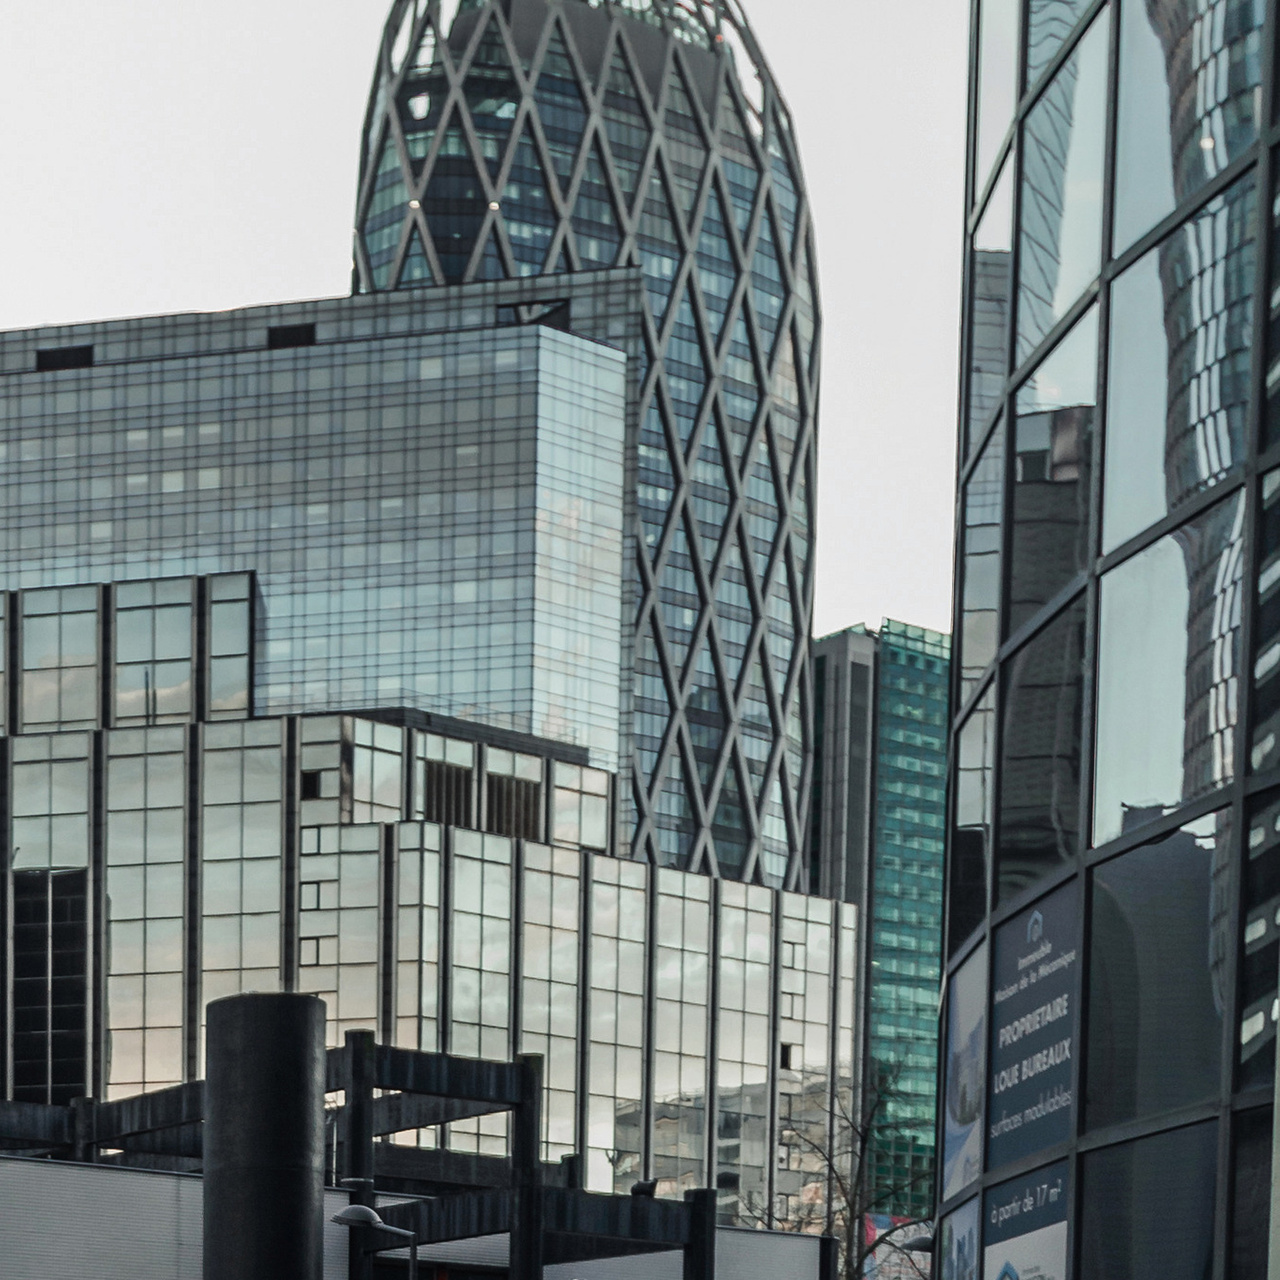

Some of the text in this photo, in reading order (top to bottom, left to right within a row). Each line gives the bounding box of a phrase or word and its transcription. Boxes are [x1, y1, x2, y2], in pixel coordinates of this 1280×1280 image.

[993, 1037, 1071, 1095] LOUE BUREAUX
[990, 1083, 1071, 1138] surfaces modulables
[998, 1195, 1021, 1228] partir
[1022, 1187, 1034, 1213] de
[1036, 1184, 1048, 1208] 17
